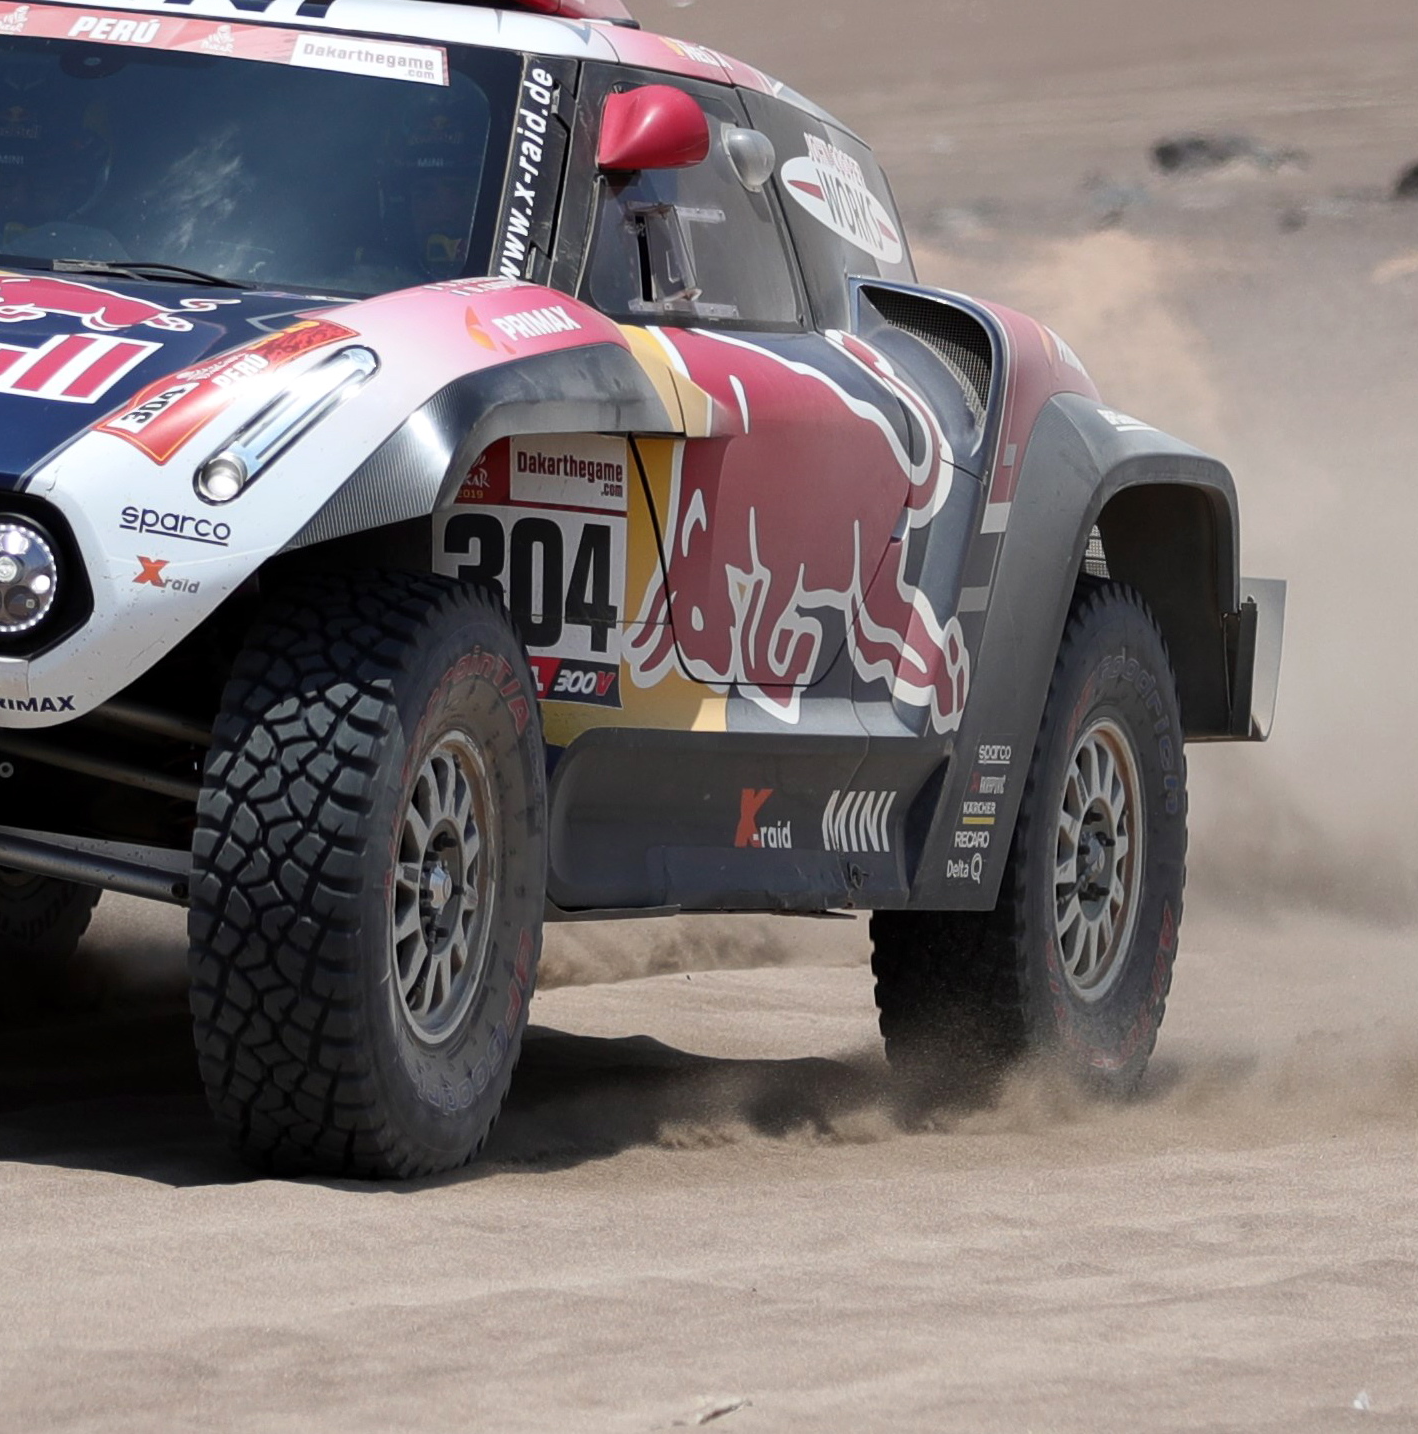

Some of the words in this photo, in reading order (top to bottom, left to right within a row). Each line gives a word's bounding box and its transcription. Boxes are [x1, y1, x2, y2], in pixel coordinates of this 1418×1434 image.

[67, 15, 161, 45] PERÚ
[303, 43, 435, 71] Dakarthegame
[404, 68, 436, 81] .com
[499, 67, 554, 282] www.x-raid.de
[816, 168, 884, 252] WORKS
[491, 305, 582, 342] PRIMAX
[517, 451, 623, 483] Dakarthegame
[600, 482, 623, 498] .com
[121, 506, 231, 541] sparco
[444, 513, 618, 653] 304
[553, 670, 617, 697] 300V
[978, 745, 1012, 760] sparco
[821, 789, 898, 853] MINI
[954, 831, 990, 849] RECARO
